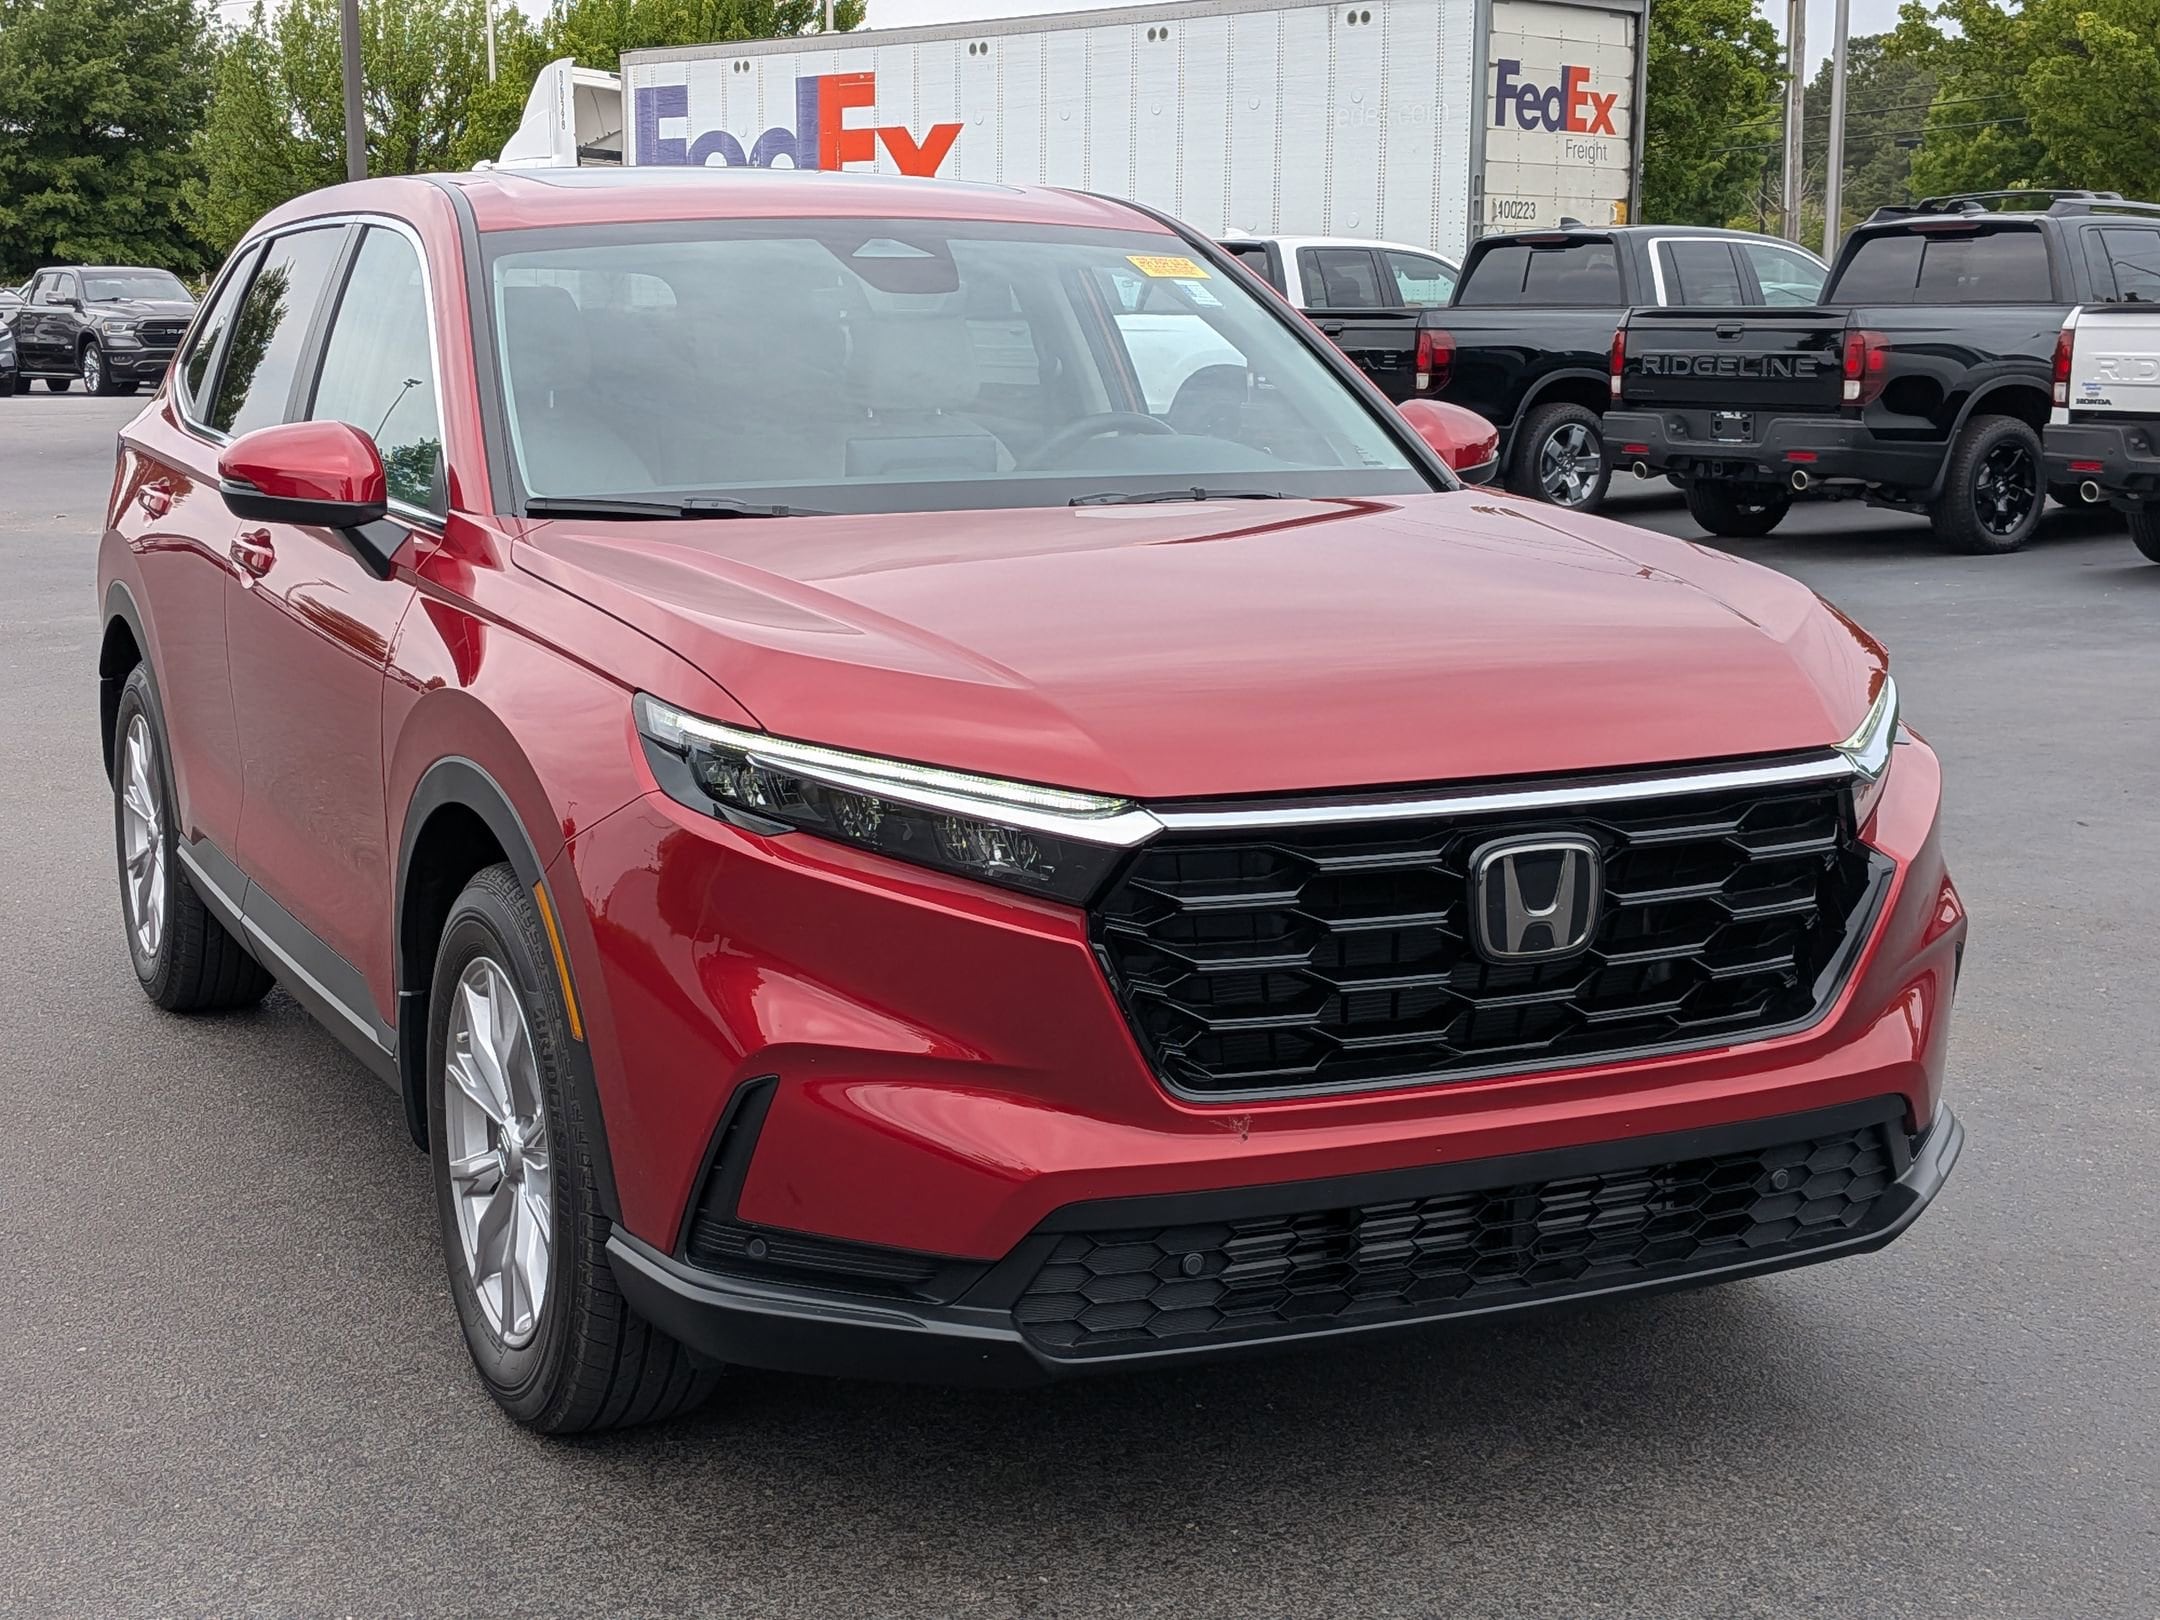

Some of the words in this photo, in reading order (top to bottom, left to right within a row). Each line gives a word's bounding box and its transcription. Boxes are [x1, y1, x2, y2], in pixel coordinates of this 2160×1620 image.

[1494, 58, 1618, 135] FedEx
[1565, 139, 1608, 164] Freight
[1641, 354, 1819, 378] RIDGELINE
[2076, 398, 2112, 406] HONDA
